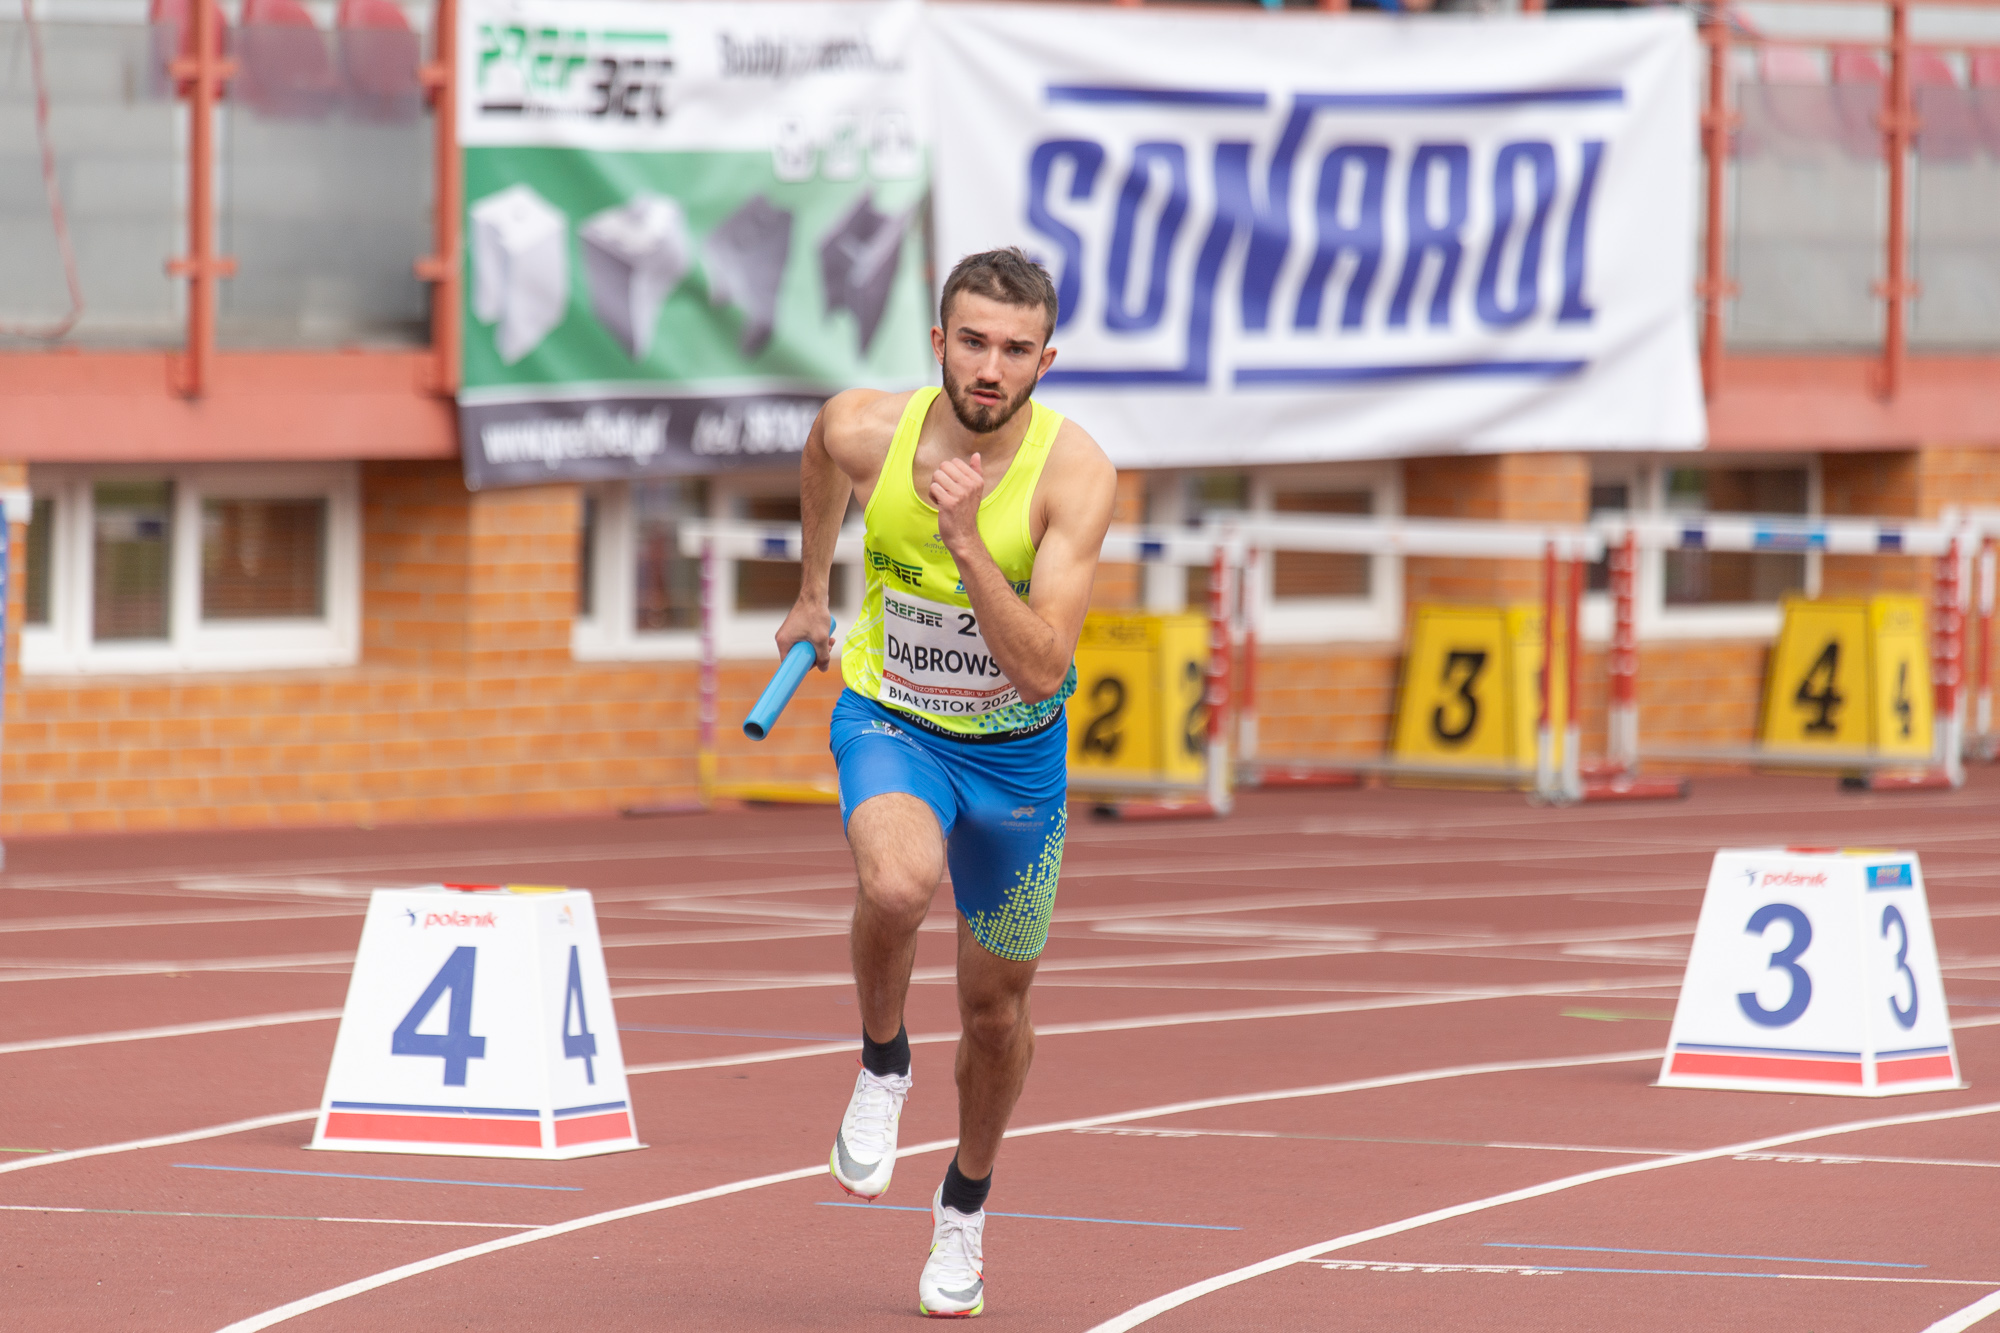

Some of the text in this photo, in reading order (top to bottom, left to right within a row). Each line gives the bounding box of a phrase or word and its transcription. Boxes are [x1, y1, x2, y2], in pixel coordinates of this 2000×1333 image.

[1026, 100, 1612, 372] SONAROL
[888, 634, 1001, 678] DĄBROWS
[957, 612, 982, 638] 2
[888, 685, 1019, 713] BIAŁYSTOK 2022
[901, 679, 949, 694] MISTRZOSTWA
[949, 689, 976, 697] POLSKI
[1081, 674, 1127, 758] 2
[1431, 650, 1488, 744] 3
[1794, 639, 1844, 733] 4
[424, 911, 499, 929] polanik
[1760, 870, 1829, 888] polanik
[1735, 902, 1814, 1031] 3
[1879, 904, 1919, 1032] 3
[390, 945, 487, 1087] 4
[562, 944, 598, 1086] 4
